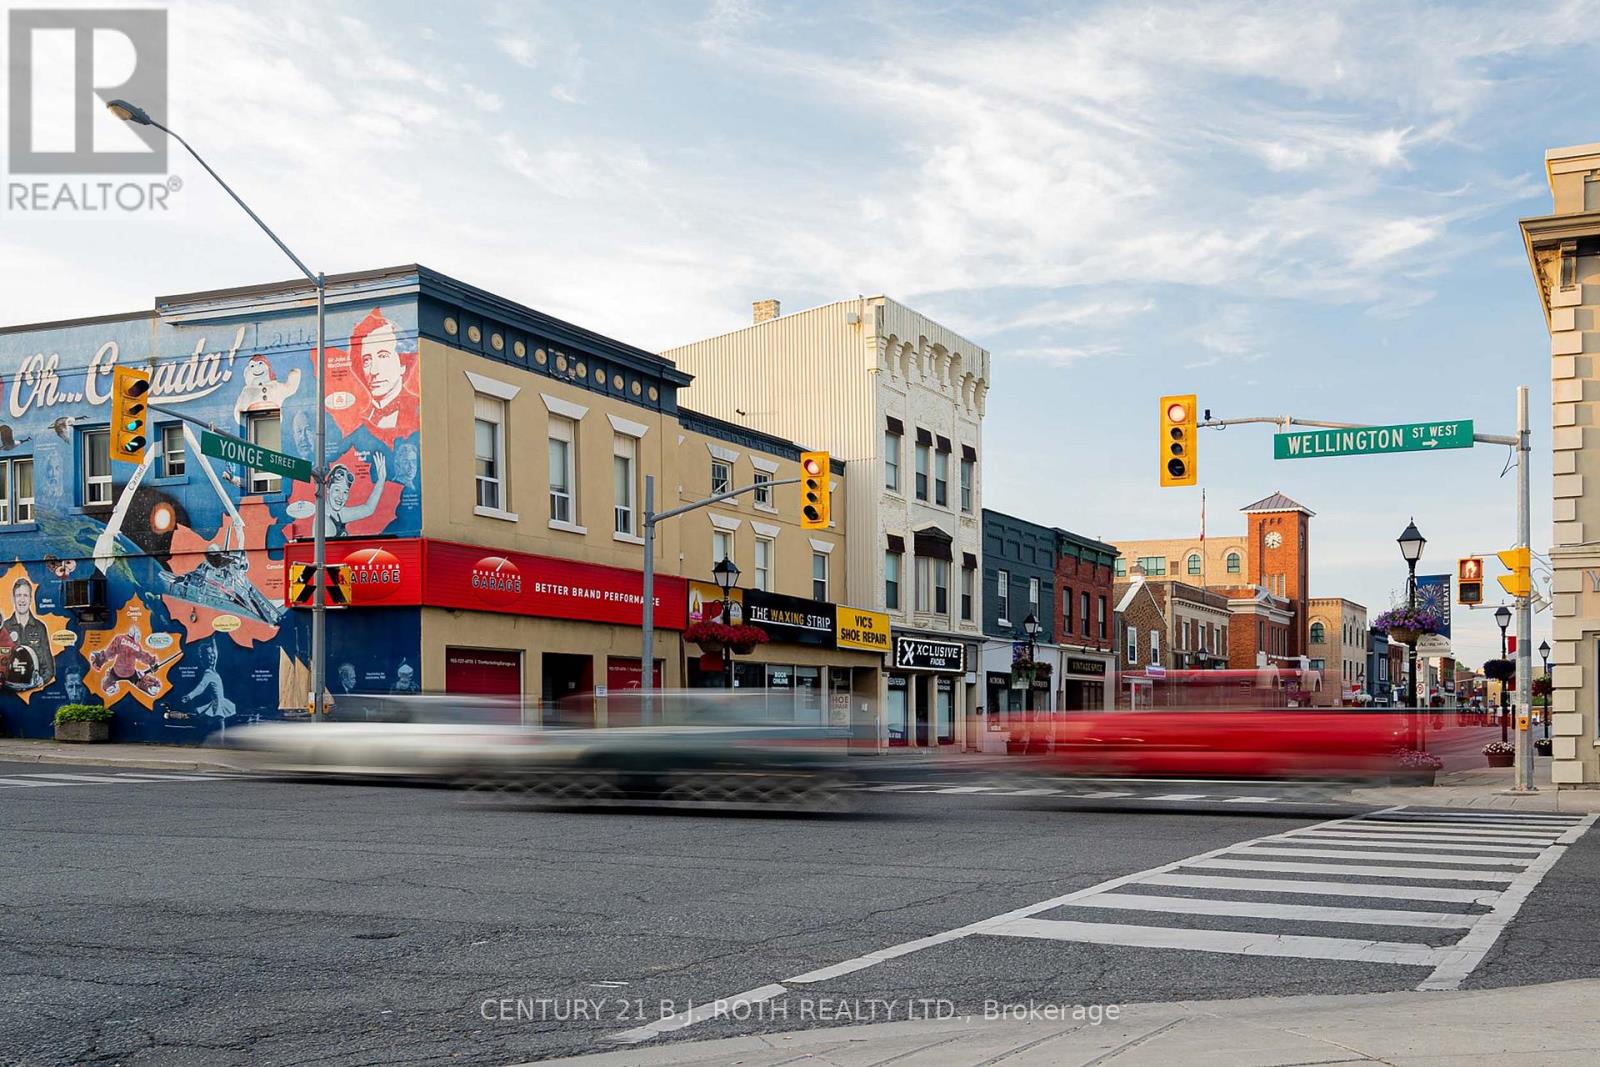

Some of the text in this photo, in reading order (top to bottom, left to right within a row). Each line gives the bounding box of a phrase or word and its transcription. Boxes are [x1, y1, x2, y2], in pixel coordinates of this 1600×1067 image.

[85, 326, 245, 405] Cada!
[1287, 425, 1458, 455] WELLINGTON ST WEST
[220, 439, 296, 470] YONGE STREET
[350, 569, 401, 584] ARAGE
[472, 569, 521, 580] MARKETING
[472, 574, 521, 593] GARAGE
[535, 582, 660, 607] BETTER BRAND PERFORMAE
[750, 605, 831, 629] THE WAXING STRIP
[855, 615, 873, 629] VIC'S
[841, 628, 887, 645] SHOE REPAIR
[916, 644, 959, 658] XCLUSIVE
